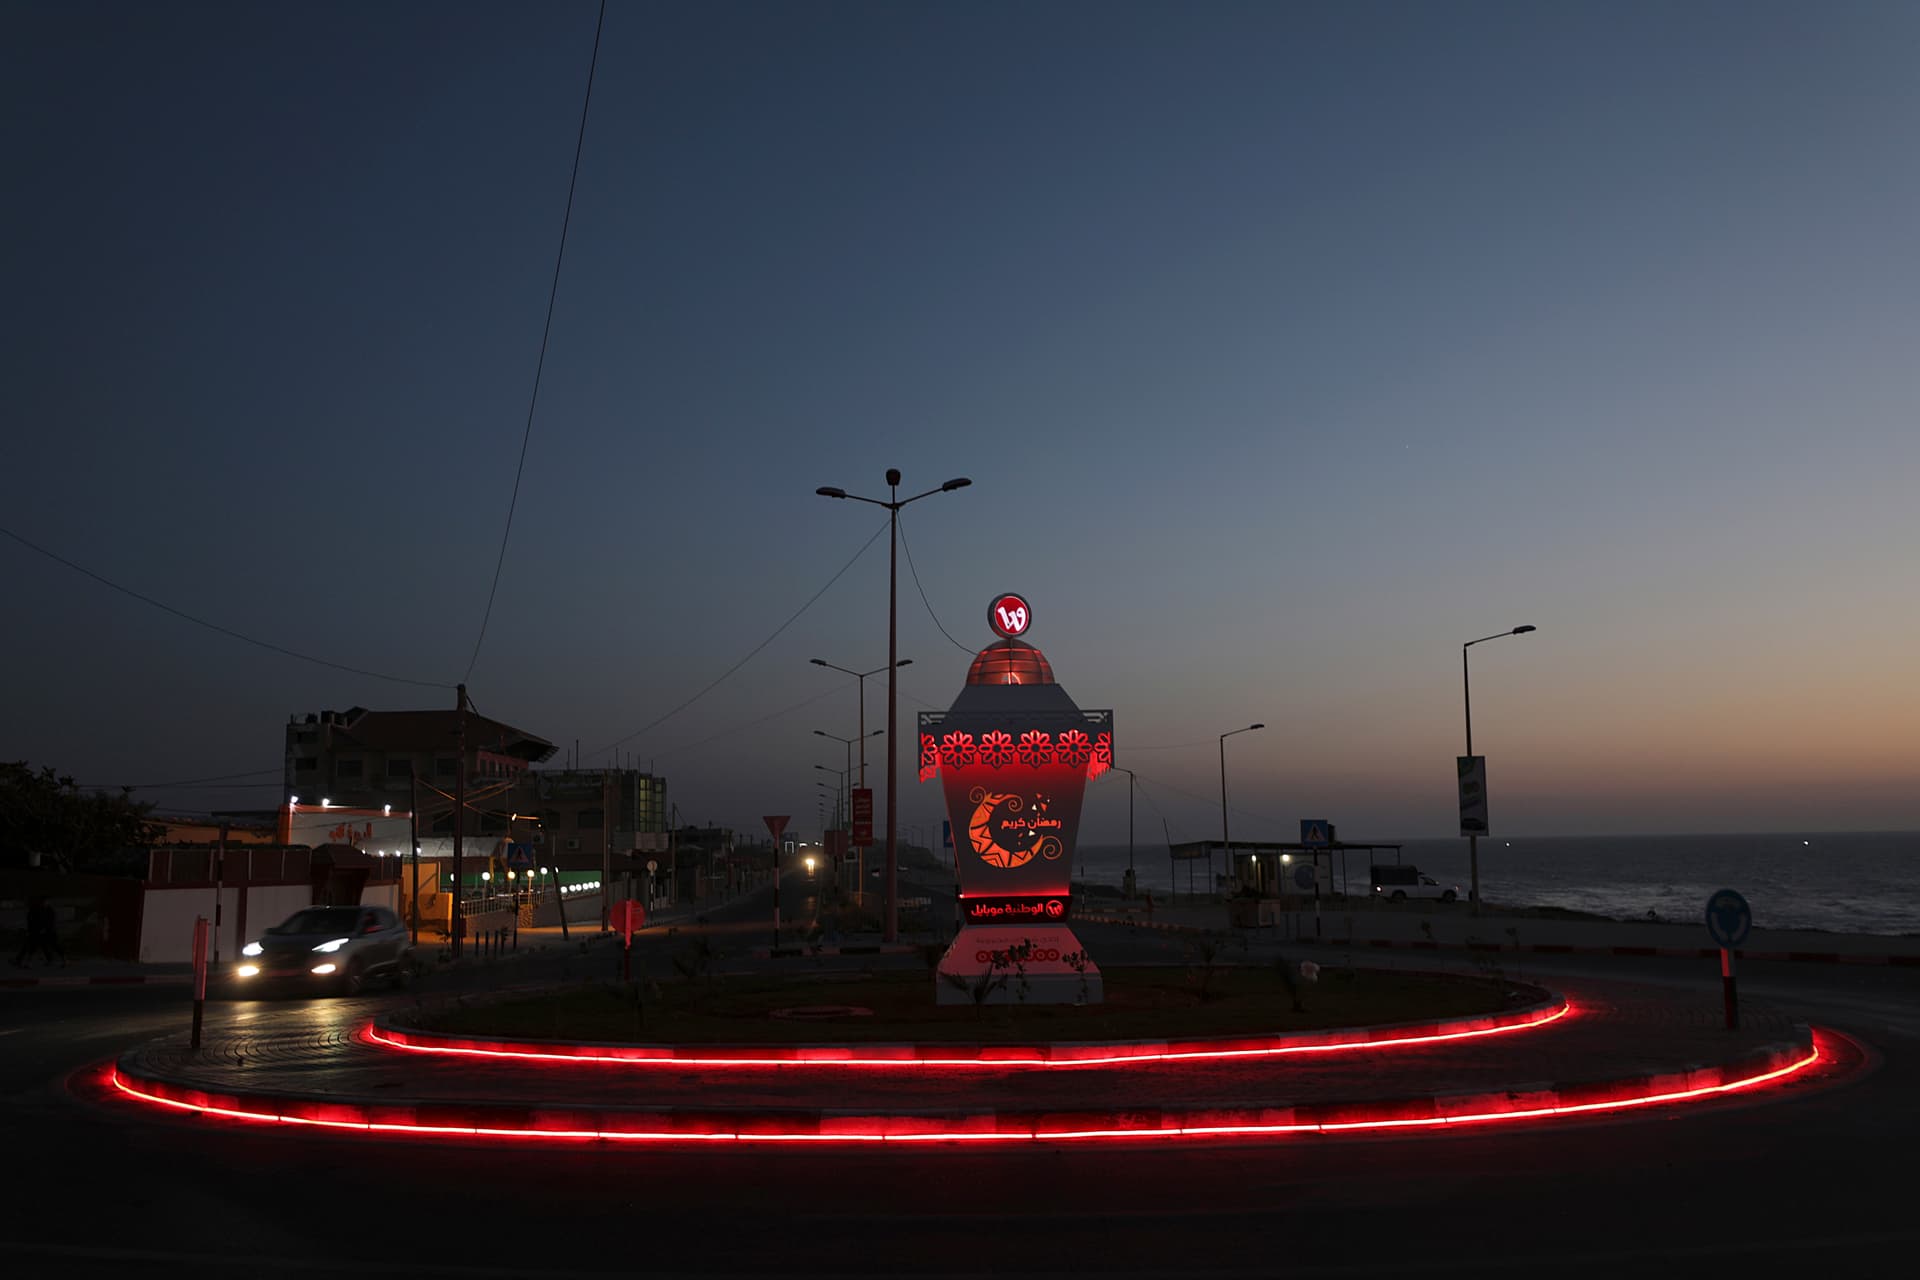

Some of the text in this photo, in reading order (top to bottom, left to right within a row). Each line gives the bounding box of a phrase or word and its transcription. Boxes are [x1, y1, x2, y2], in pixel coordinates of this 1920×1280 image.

[1001, 812, 1062, 830] رمضان كريم
[971, 903, 1043, 917] الوطنية موبايل
